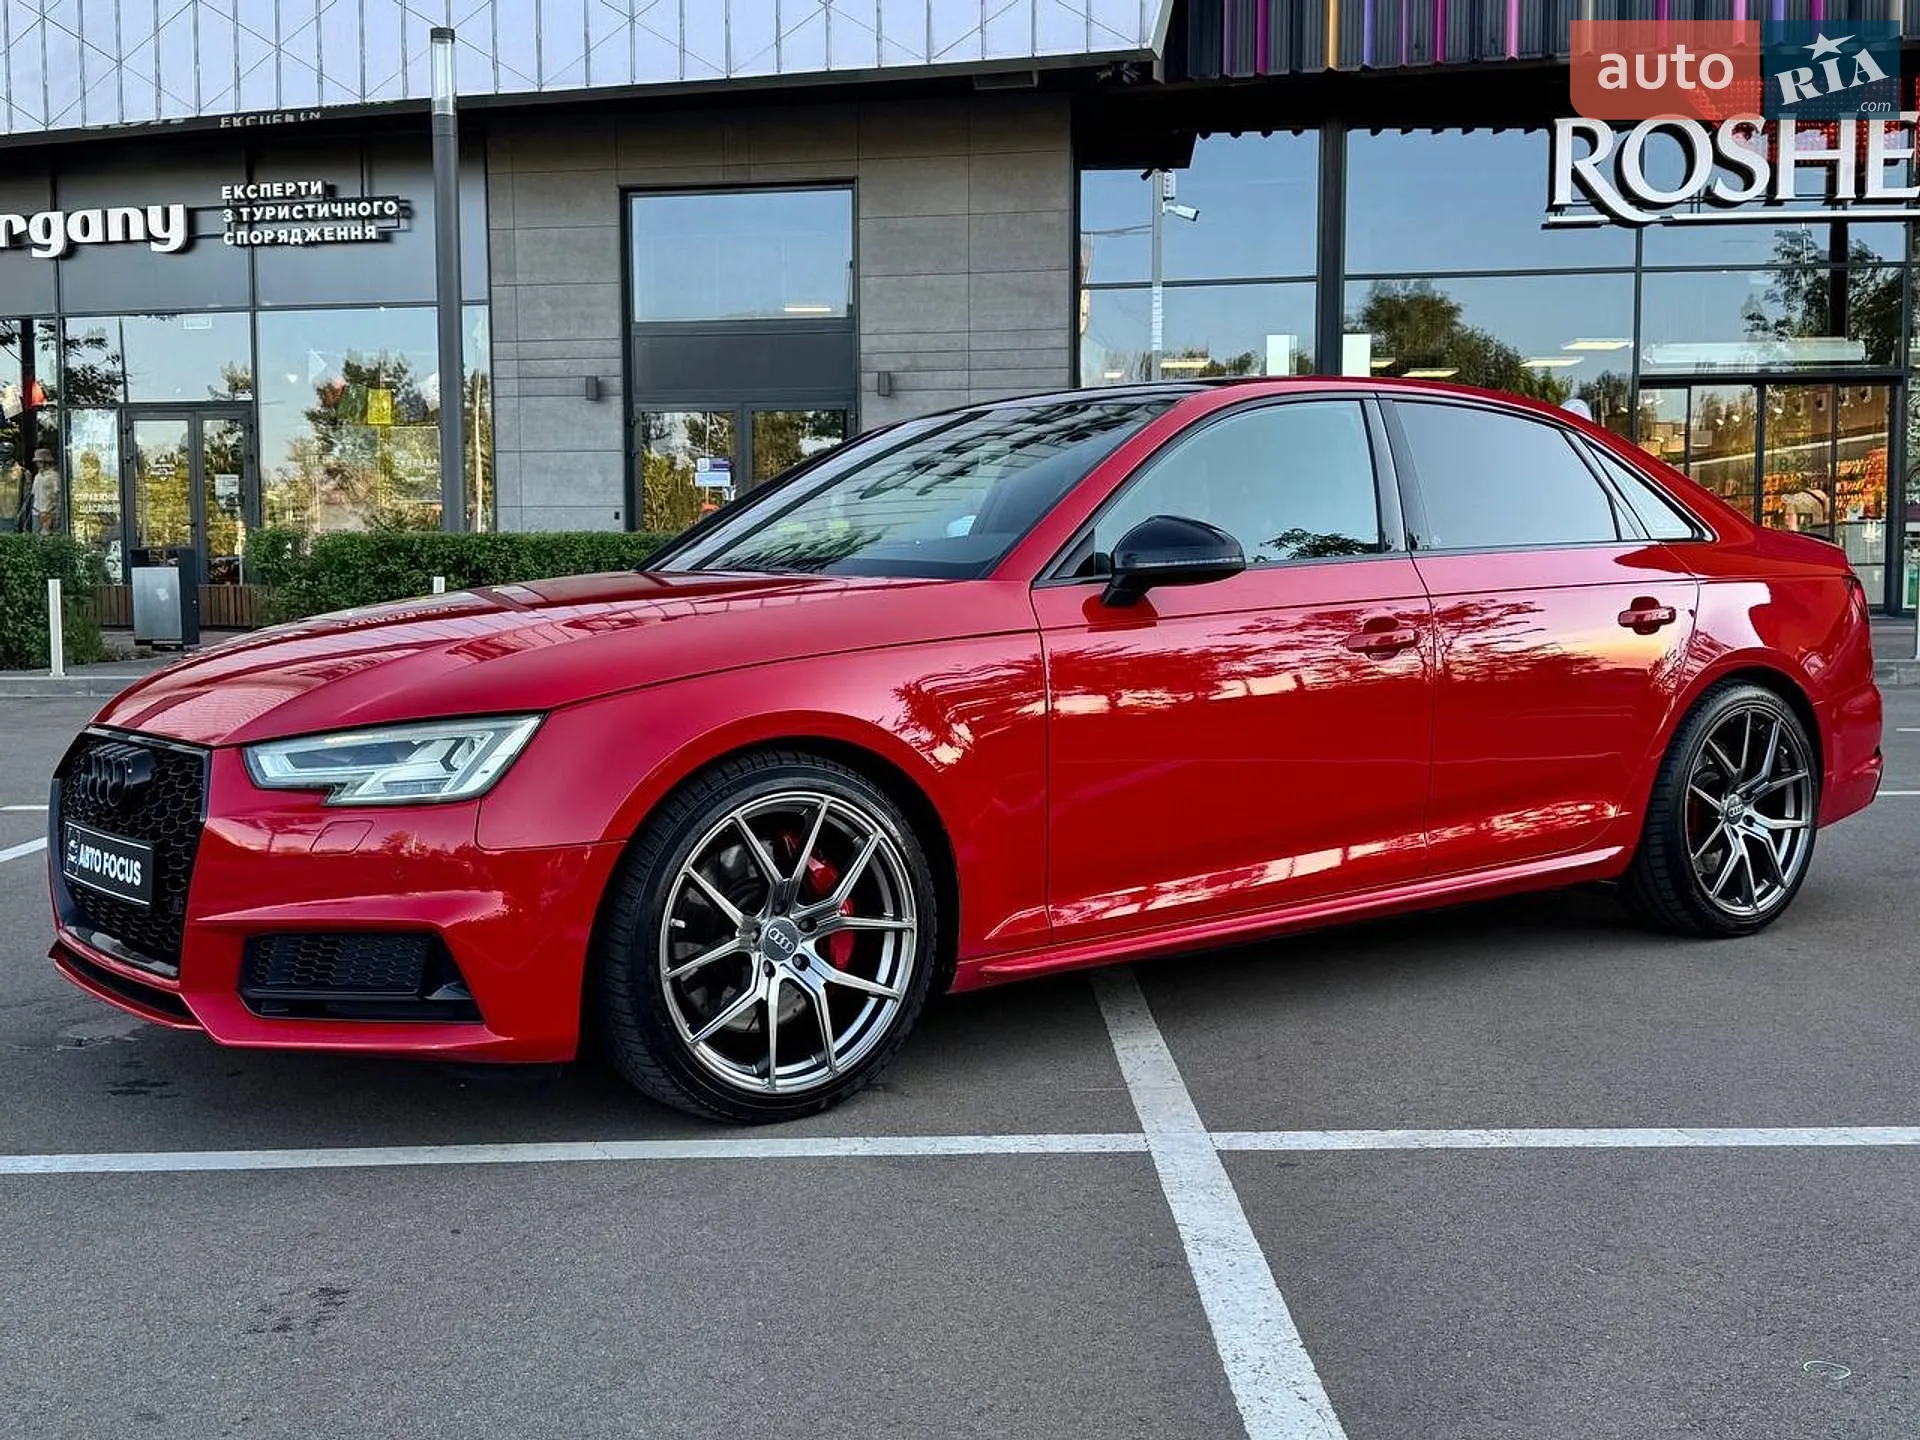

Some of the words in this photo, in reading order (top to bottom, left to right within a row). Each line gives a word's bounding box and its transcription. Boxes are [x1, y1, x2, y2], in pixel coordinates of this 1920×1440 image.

[221, 180, 323, 200] ЕКСПЕРТИ
[239, 200, 398, 222] ТУРИСТИЧНОГО
[223, 226, 377, 246] СПОРЯДЖЕННЯ
[103, 852, 142, 886] FOCUS
